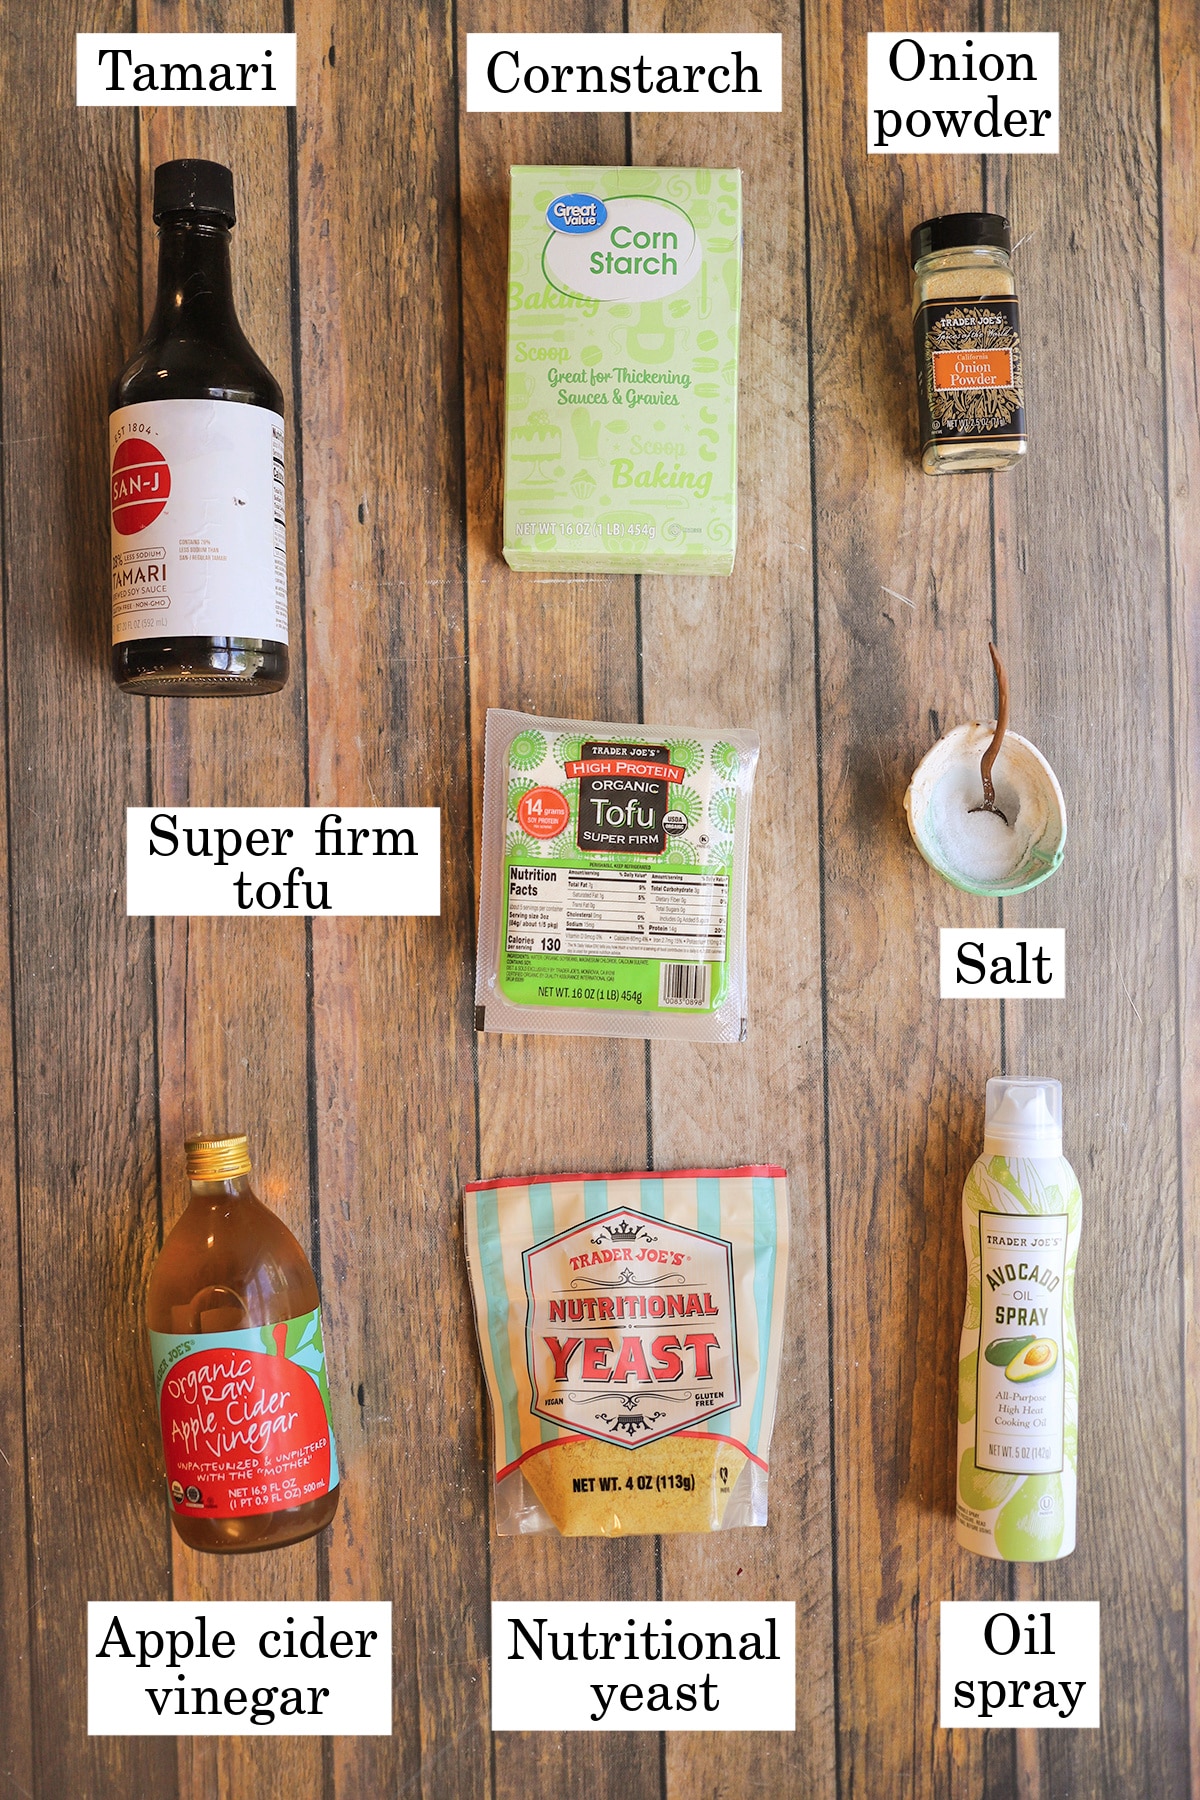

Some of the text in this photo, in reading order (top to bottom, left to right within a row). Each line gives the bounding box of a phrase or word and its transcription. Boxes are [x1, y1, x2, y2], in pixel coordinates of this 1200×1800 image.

[553, 202, 597, 217] Great
[564, 215, 596, 226] Value
[610, 226, 678, 249] Corn
[589, 252, 678, 275] Starch
[509, 282, 600, 317] Baking
[940, 316, 1002, 327] TRADER JOE'S
[515, 342, 571, 364] Scoop
[955, 361, 991, 374] Onion
[548, 368, 692, 388] Great for Thickening
[951, 373, 997, 386] Powder
[557, 389, 680, 408] Sauces & Gravies
[114, 423, 151, 443] EST 1804
[629, 435, 686, 458] Scoop
[113, 471, 160, 500] SAN-J
[610, 458, 713, 498] Baking
[515, 522, 536, 536] NET
[538, 522, 556, 536] WT
[559, 523, 573, 536] 16
[575, 523, 591, 536] OZ
[606, 523, 625, 538] LB)
[627, 523, 656, 539] 454g
[136, 551, 161, 560] SODIUM
[113, 564, 166, 589] TAMARI
[127, 588, 140, 596] SOY
[141, 585, 167, 595] SAUCE
[135, 600, 166, 608] NON-GMO
[592, 747, 656, 757] TRADER JOE'S
[573, 762, 679, 779] HIGH PROTEIN
[592, 780, 659, 794] ORGANIC
[525, 798, 564, 816] 14 grams
[590, 798, 656, 829] Tofu
[583, 831, 659, 844] SUPER FIRM
[510, 867, 557, 882] Nutrition
[510, 882, 538, 896] Facts
[508, 935, 534, 945] Calories
[541, 938, 561, 952] 130
[538, 986, 554, 997] NET
[555, 987, 570, 998] WT.
[572, 989, 582, 999] 16
[584, 990, 594, 1000] OZ
[606, 990, 619, 1002] LB)
[621, 990, 642, 1005] 454g
[987, 1235, 1059, 1247] TRADER JOE'S
[569, 1248, 686, 1271] TRADER JOE'S
[986, 1263, 1060, 1293] AVOCADO
[1013, 1290, 1033, 1301] OIL
[548, 1293, 719, 1323] NUTRITIONAL
[995, 1306, 1049, 1326] SPRAY
[169, 1341, 192, 1363] JOE'S
[543, 1333, 721, 1383] YEAST
[168, 1352, 252, 1404] Organic
[201, 1376, 255, 1405] Raw
[695, 1391, 724, 1401] GLUTEN
[995, 1391, 1047, 1404] All-Purpose
[545, 1398, 564, 1406] VEGAN
[695, 1399, 714, 1407] FREE
[998, 1404, 1044, 1415] High Heat
[171, 1389, 290, 1454] Apple Cider
[994, 1416, 1047, 1429] Cooking Oil
[989, 1443, 1051, 1460] NET WT. 5 OZ (142g)
[177, 1459, 259, 1472] UNPASTEURIZED
[264, 1456, 272, 1466] &
[197, 1473, 226, 1482] WITH
[229, 1471, 253, 1481] THE
[573, 1473, 695, 1493] NET WT. 4 OZ (113g)
[228, 1478, 297, 1498] NET 16.9 FL OZ
[240, 1497, 252, 1508] PT
[255, 1495, 269, 1506] 0.9
[271, 1492, 282, 1503] FL
[284, 1488, 302, 1500] OZ)
